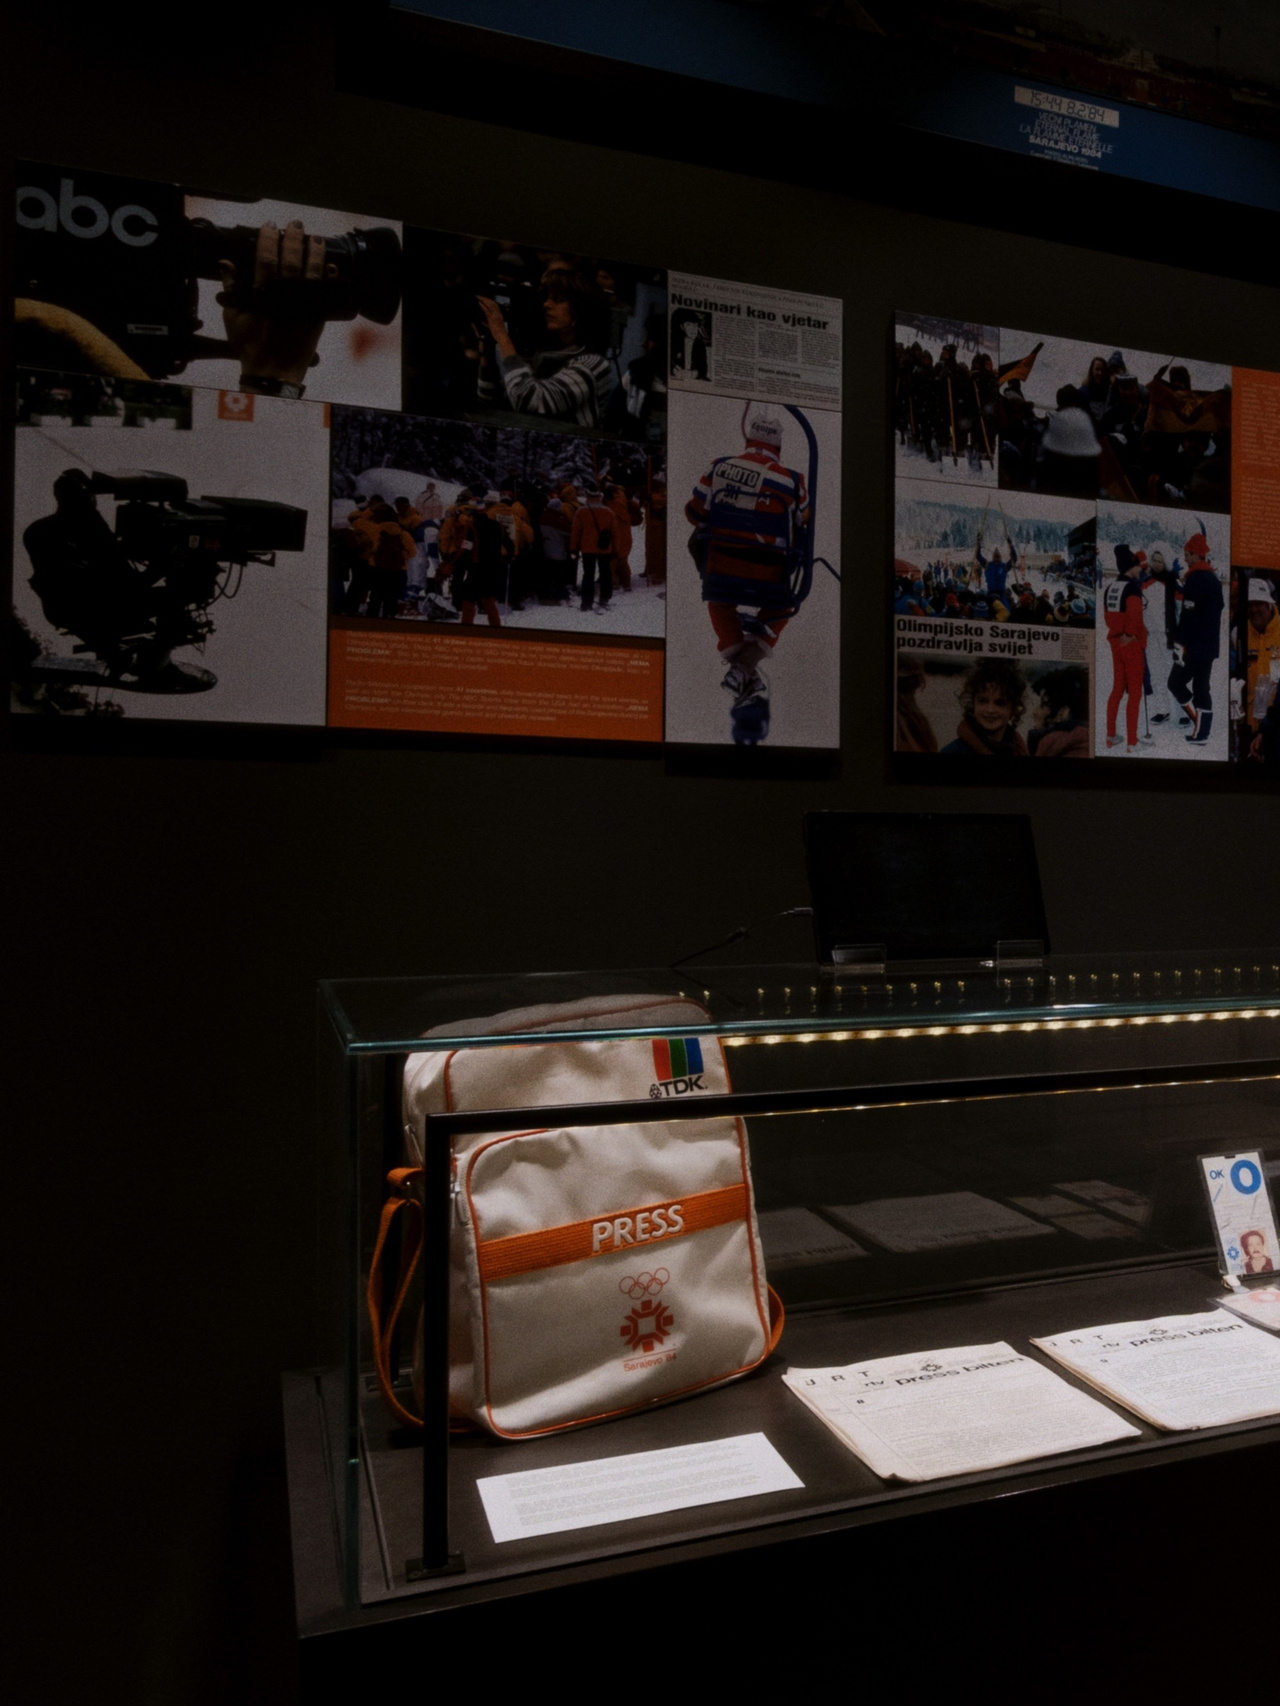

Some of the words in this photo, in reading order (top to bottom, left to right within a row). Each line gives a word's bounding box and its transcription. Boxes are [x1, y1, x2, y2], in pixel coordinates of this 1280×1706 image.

[1019, 124, 1031, 133] LA
[1035, 120, 1070, 136] ETERNAL
[1028, 135, 1079, 153] SARAJEVO
[1081, 147, 1102, 159] 1984
[15, 178, 160, 247] abc
[671, 293, 741, 316] Novinari
[746, 306, 776, 322] kao
[782, 314, 829, 330] vjetar
[716, 463, 758, 486] PHOTO
[896, 619, 984, 637] Olimpijsko
[989, 625, 1060, 642] Sarajevo
[896, 637, 983, 652] pozdravlja
[988, 641, 1033, 656] svijet
[659, 1075, 704, 1096] TDK
[1209, 1169, 1225, 1180] OK
[592, 1204, 684, 1252] PRESS
[1129, 1333, 1187, 1347] press
[1187, 1323, 1244, 1337] bilten
[623, 1357, 664, 1372] Sarajevo
[895, 1369, 961, 1386] press
[962, 1357, 1025, 1372] bilten
